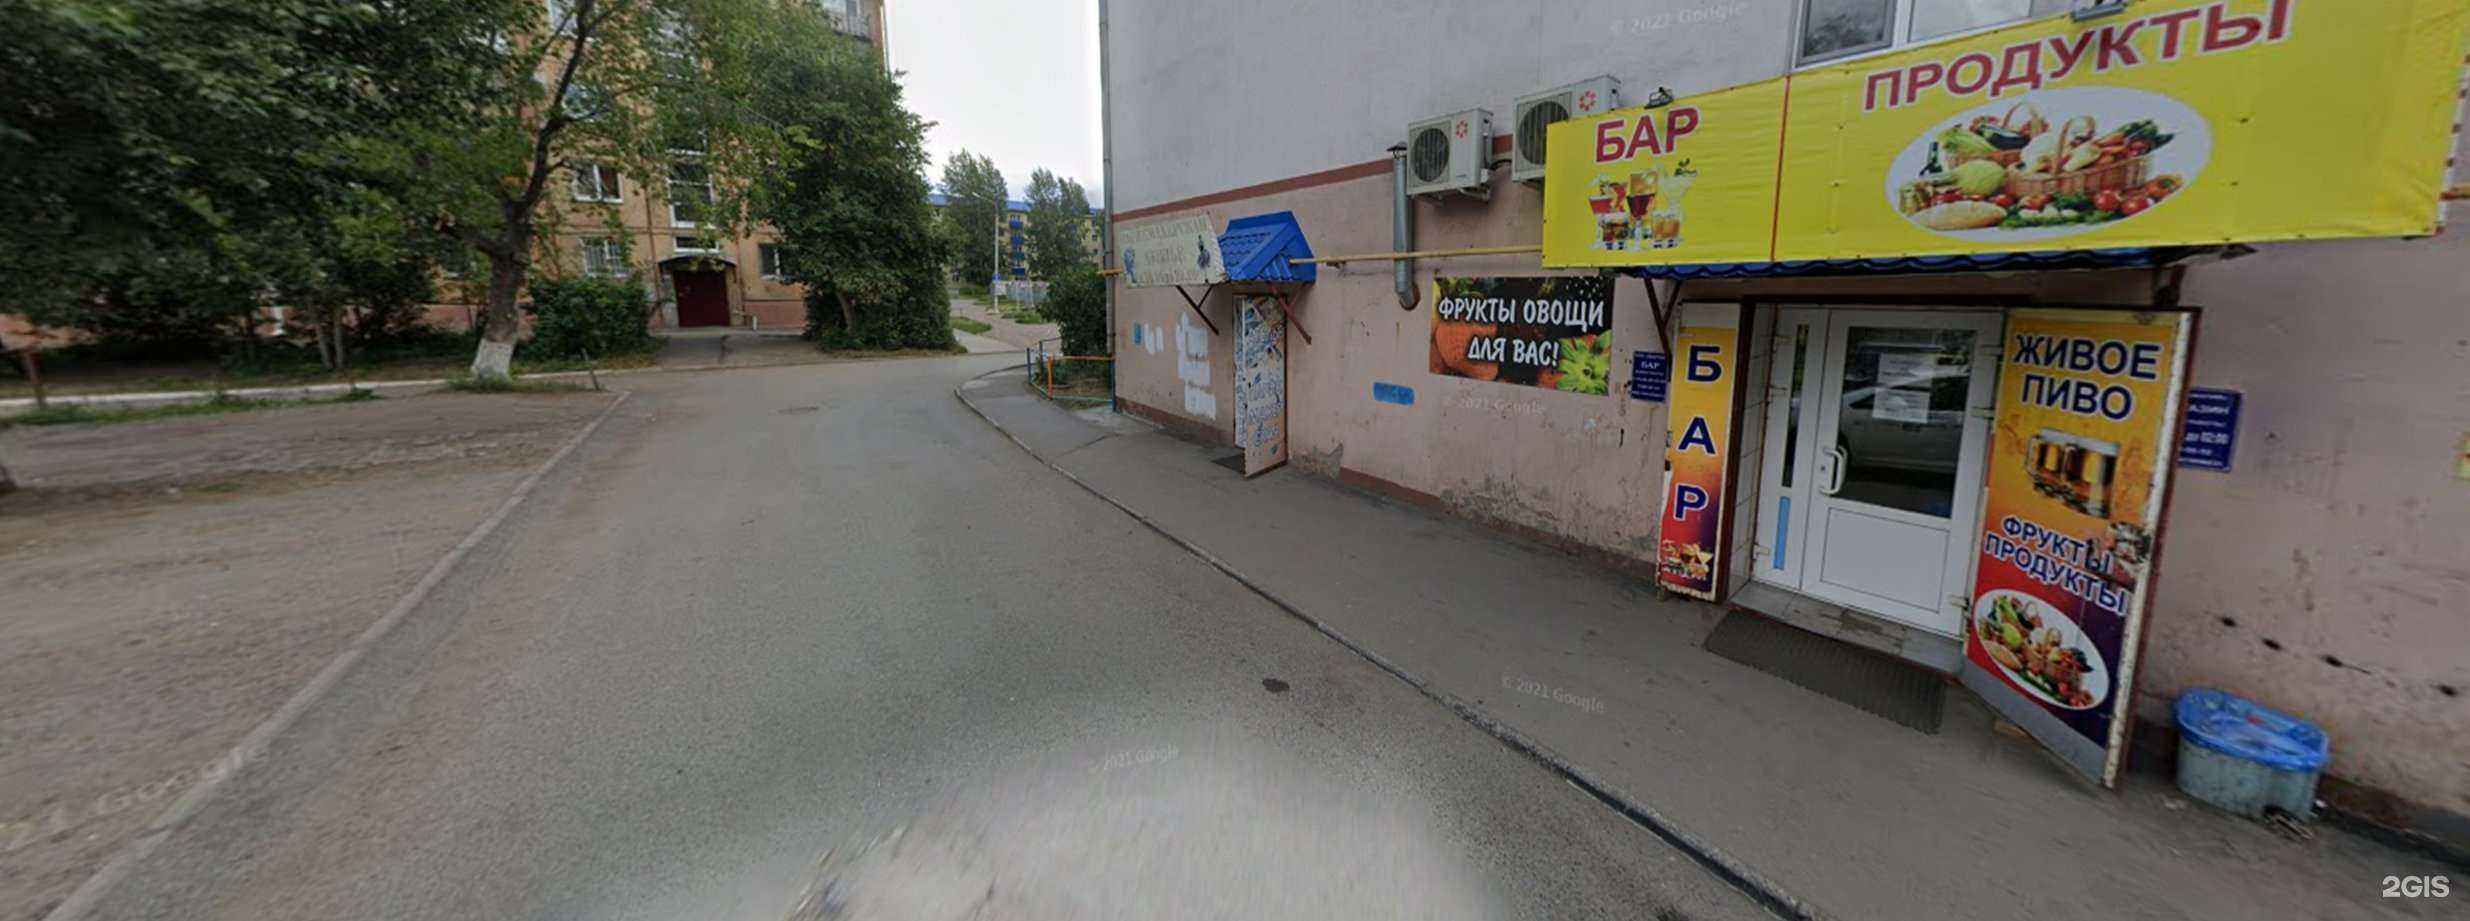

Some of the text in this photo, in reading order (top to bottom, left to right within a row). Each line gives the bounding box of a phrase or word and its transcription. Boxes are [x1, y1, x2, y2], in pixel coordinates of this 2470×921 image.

[1864, 0, 2292, 110] ПРОДУКТЫ
[1596, 107, 1699, 163] БАР
[1438, 297, 1604, 332] ФРУКТЫ ОВОЩИ
[1467, 337, 1559, 367] ДЛЯ ВАС!
[1641, 360, 1660, 370] БАР
[2013, 334, 2162, 380] ЖИВОЕ
[2021, 373, 2134, 421] ПИВО
[2002, 516, 2111, 574] ФРУКТЫ
[1984, 532, 2129, 615] ПРОДУКТЫ
